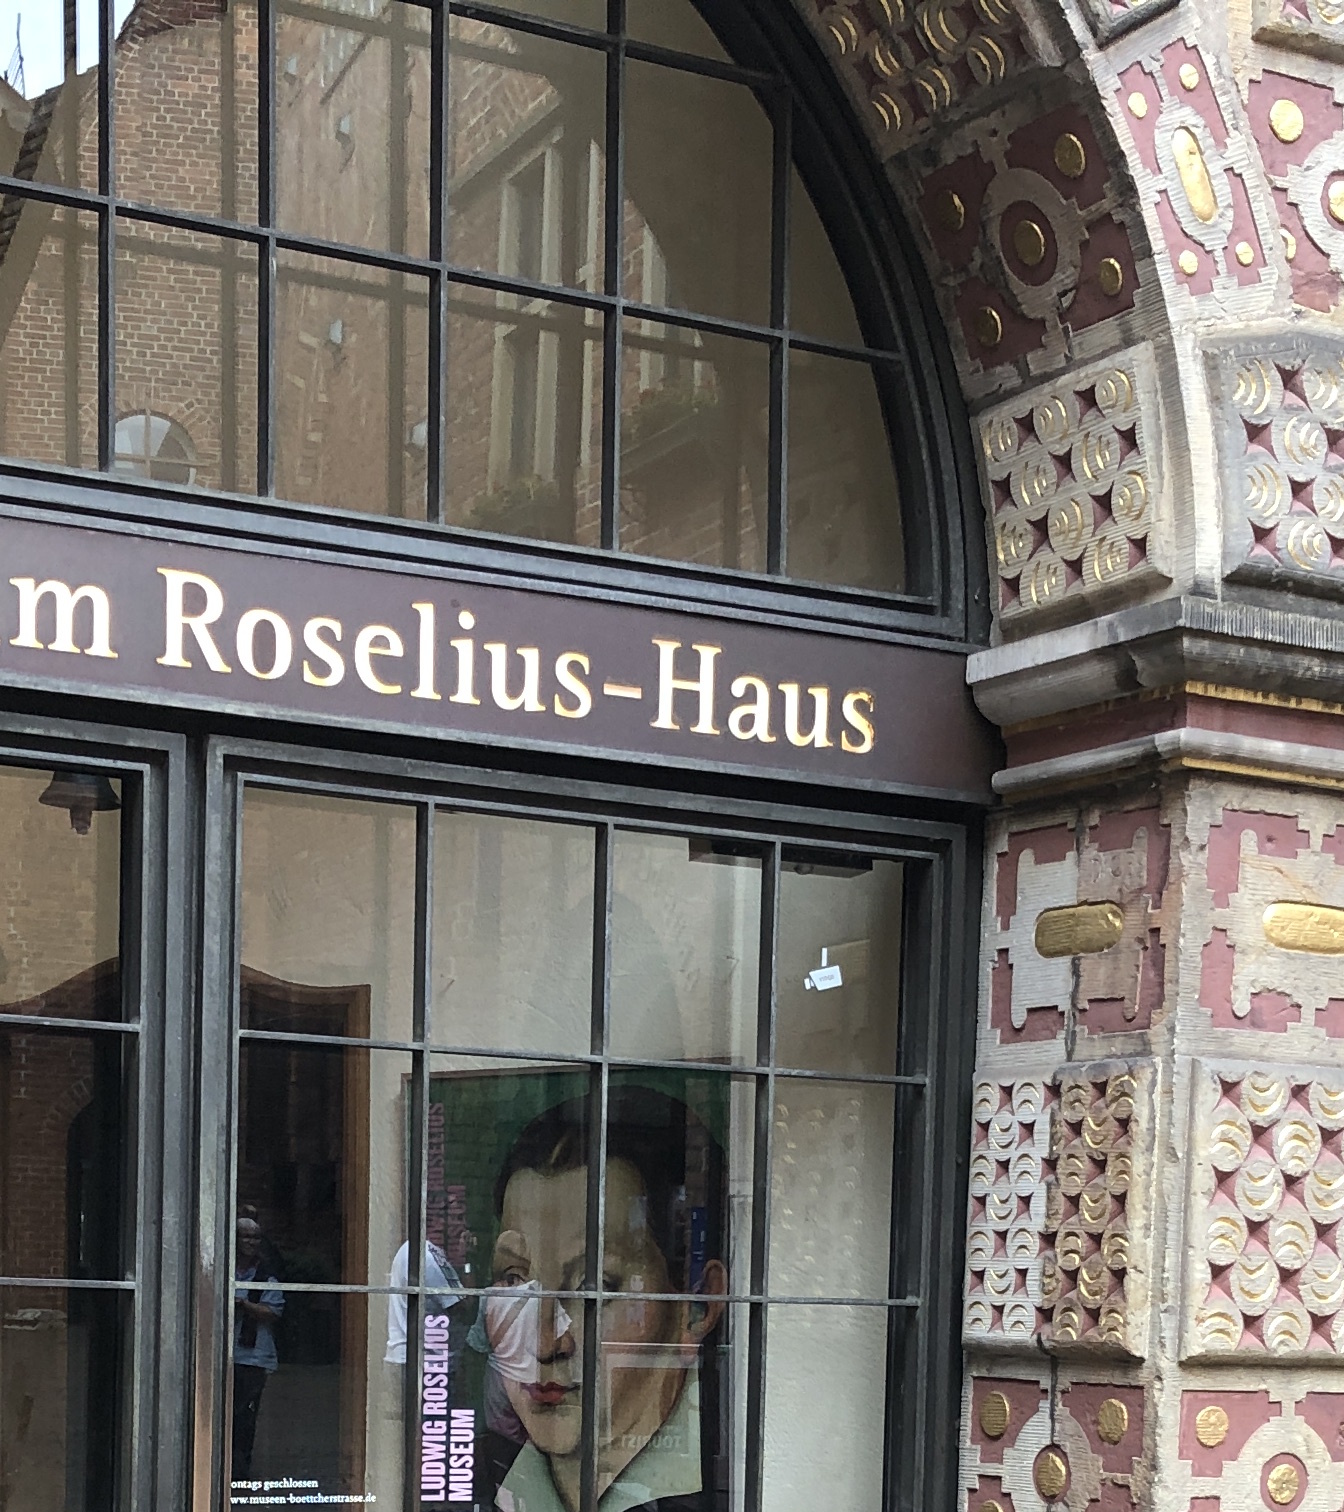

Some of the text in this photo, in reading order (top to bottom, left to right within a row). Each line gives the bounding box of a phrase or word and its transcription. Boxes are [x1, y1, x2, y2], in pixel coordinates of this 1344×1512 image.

[156, 567, 875, 754] Roselius-Haus
[421, 1314, 450, 1502] LUDWIG ROSELIUS
[448, 1408, 476, 1502] MUSEUM
[230, 1477, 319, 1491] ontags geschlossen
